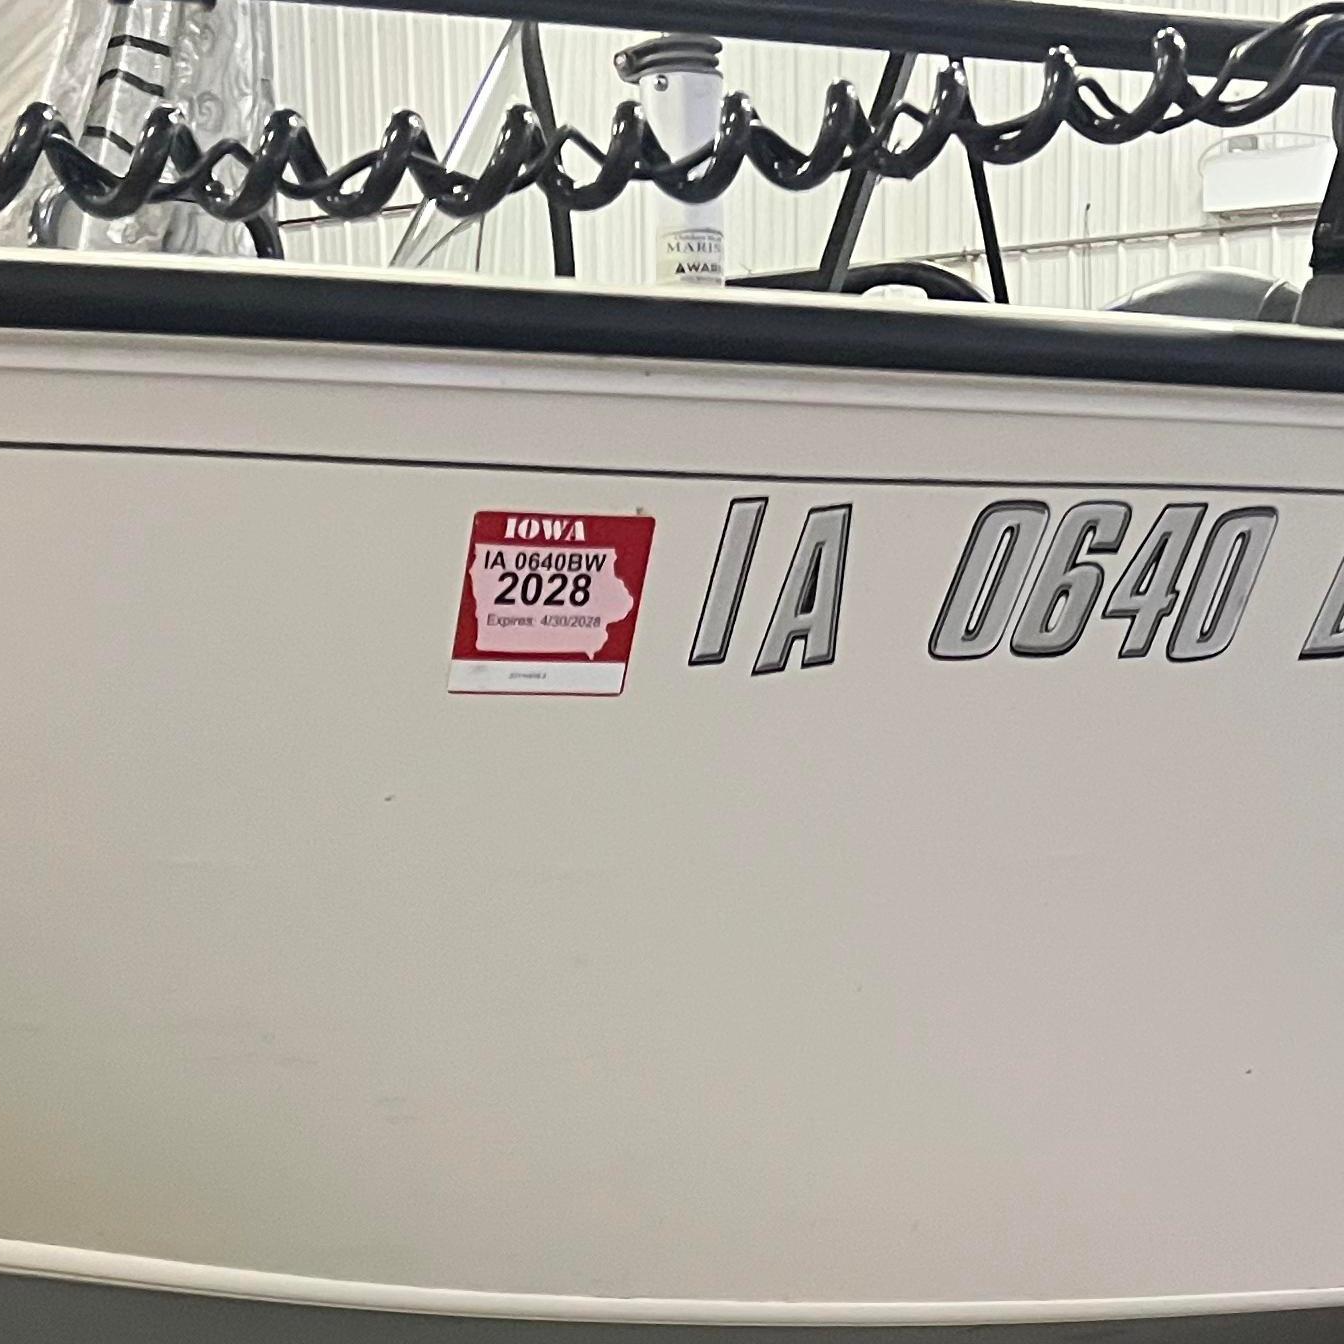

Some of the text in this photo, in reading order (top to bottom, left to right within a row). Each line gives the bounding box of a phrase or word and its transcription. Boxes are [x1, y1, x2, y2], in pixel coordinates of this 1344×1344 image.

[504, 517, 586, 542] IOWA
[484, 550, 607, 573] IA 0640BW
[494, 571, 592, 607] 2028
[687, 496, 853, 676] IA
[928, 500, 1279, 662] 0640
[540, 614, 602, 629] 4/30/2028
